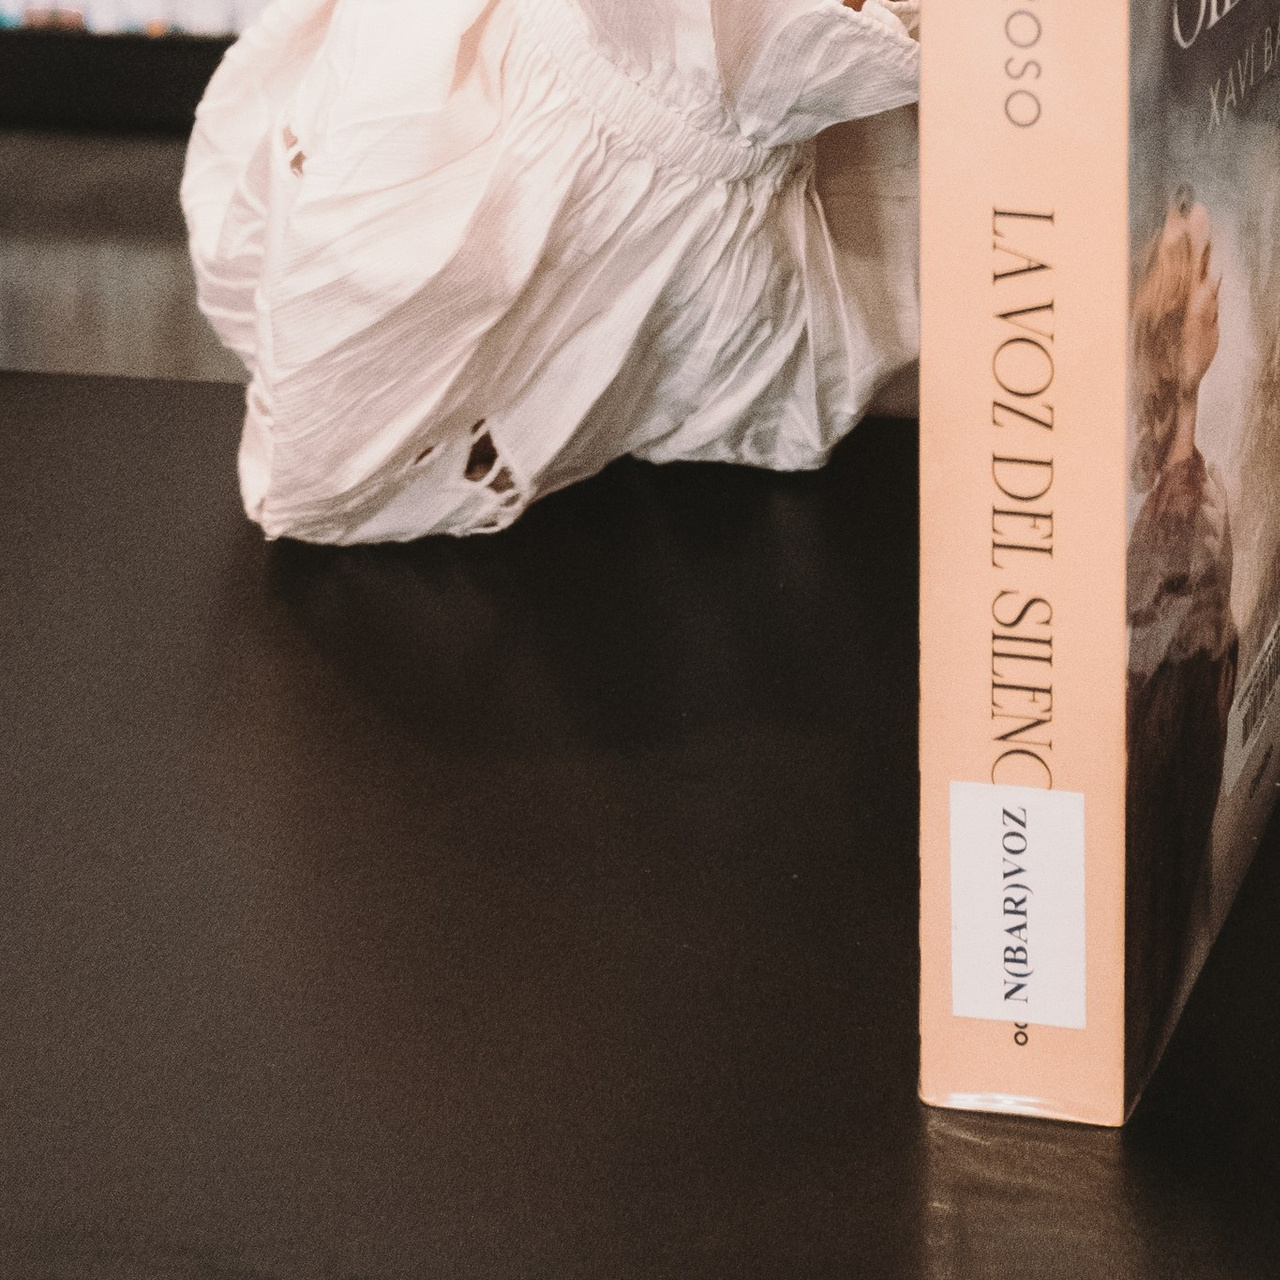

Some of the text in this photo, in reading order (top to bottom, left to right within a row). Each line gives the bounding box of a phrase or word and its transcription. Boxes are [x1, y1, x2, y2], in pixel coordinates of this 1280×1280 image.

[1208, 42, 1255, 134] XAVI
[991, 207, 1054, 790] LA VOZ DEL SILENC
[1002, 806, 1034, 1003] N(BAR)VOZ
